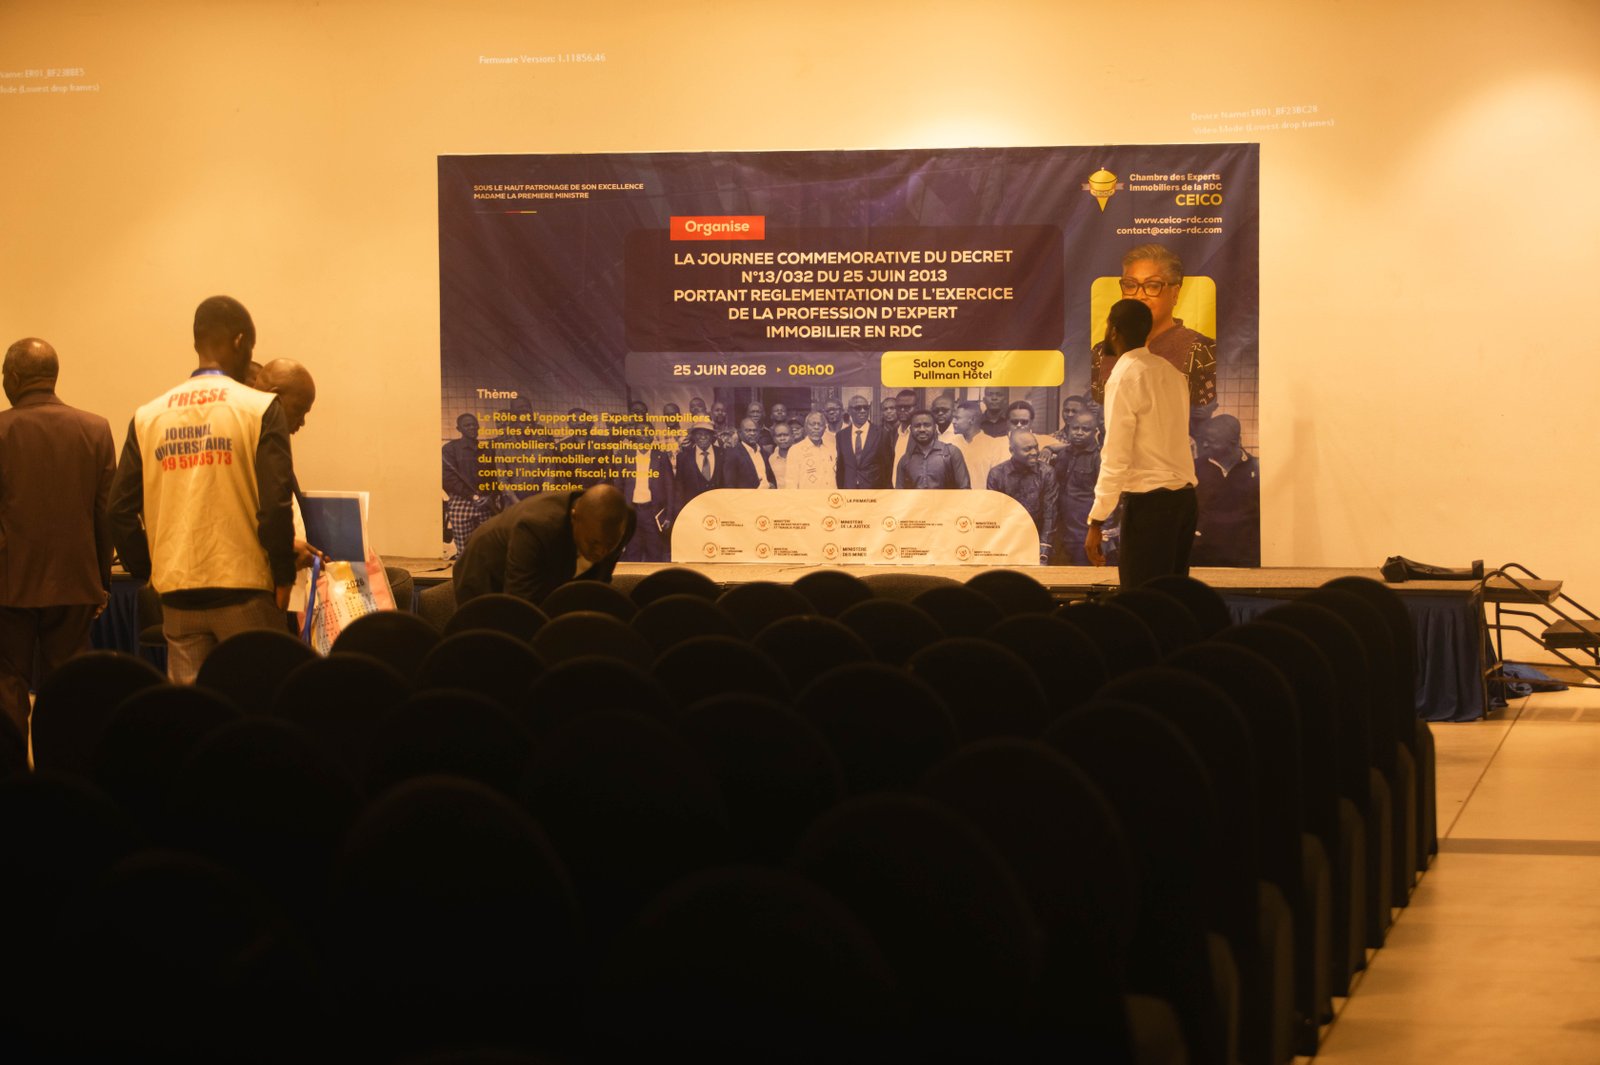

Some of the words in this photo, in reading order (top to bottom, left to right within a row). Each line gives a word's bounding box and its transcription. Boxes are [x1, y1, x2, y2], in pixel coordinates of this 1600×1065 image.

[479, 55, 519, 64] Firmware
[520, 54, 555, 63] Version:
[1129, 173, 1168, 182] Chambre
[1169, 173, 1185, 182] des
[1187, 173, 1220, 183] Experts
[1129, 183, 1180, 192] Immobiliers
[1181, 183, 1192, 191] de
[1193, 183, 1202, 191] la
[1203, 182, 1222, 191] RDC
[1175, 193, 1222, 206] CEICO
[1134, 216, 1222, 225] www.ceico-rdc.com
[685, 220, 750, 236] Organise
[1116, 226, 1222, 236] contact@ceico-rdc.com
[674, 253, 695, 265] LA
[697, 252, 774, 265] JOURNEE
[777, 251, 920, 265] COMMEMORATIVE
[924, 251, 947, 263] DU
[951, 250, 1013, 263] DECRET
[741, 270, 814, 284] N°13/032
[817, 271, 840, 283] DU
[843, 270, 863, 283] 25
[867, 270, 905, 282] JUIN
[909, 269, 948, 282] 2013
[673, 289, 748, 302] PORTANT
[751, 288, 894, 301] REGLEMENTATION
[897, 288, 918, 300] DE
[922, 287, 1013, 300] L'EXERCICE
[728, 307, 749, 320] DE
[752, 307, 774, 320] LA
[776, 307, 877, 320] PROFESSION
[881, 306, 958, 319] D'EXPERT
[766, 325, 861, 338] IMMOBILIER
[864, 325, 886, 338] EN
[890, 325, 923, 337] RDC
[673, 364, 692, 376] 25
[694, 364, 729, 376] JUIN
[730, 364, 766, 376] 2026
[788, 364, 834, 376] 08h00
[913, 358, 945, 368] Salon
[948, 358, 984, 371] Congo
[913, 370, 960, 380] Pullman
[963, 369, 992, 379] Hôtel
[167, 388, 229, 408] PRESSE
[476, 388, 518, 399] Thème
[478, 412, 490, 422] Le
[493, 412, 517, 422] Rôle
[519, 413, 531, 422] et
[533, 412, 577, 424] l'apport
[579, 412, 598, 422] des
[601, 412, 643, 424] Experts
[646, 412, 710, 422] immobiliers
[165, 423, 212, 441] JOURNAL
[478, 427, 504, 436] dans
[506, 426, 522, 436] les
[524, 426, 588, 436] évaluations
[590, 426, 609, 436] des
[612, 426, 641, 436] biens
[644, 426, 688, 437] fonciers
[478, 440, 489, 449] et
[491, 440, 558, 452] immobiliers,
[560, 442, 586, 452] pour
[588, 440, 679, 450] l'assainissement
[216, 451, 232, 466] 73
[478, 454, 491, 463] du
[494, 454, 536, 463] marché
[538, 454, 595, 463] immobilier
[597, 455, 610, 464] et
[612, 454, 622, 464] la
[478, 468, 514, 478] contre
[515, 468, 572, 478] l'incivisme
[574, 468, 607, 479] fiscal;
[609, 468, 619, 478] la
[621, 468, 660, 478] frade
[479, 482, 490, 491] et
[492, 482, 540, 491] l'évasion
